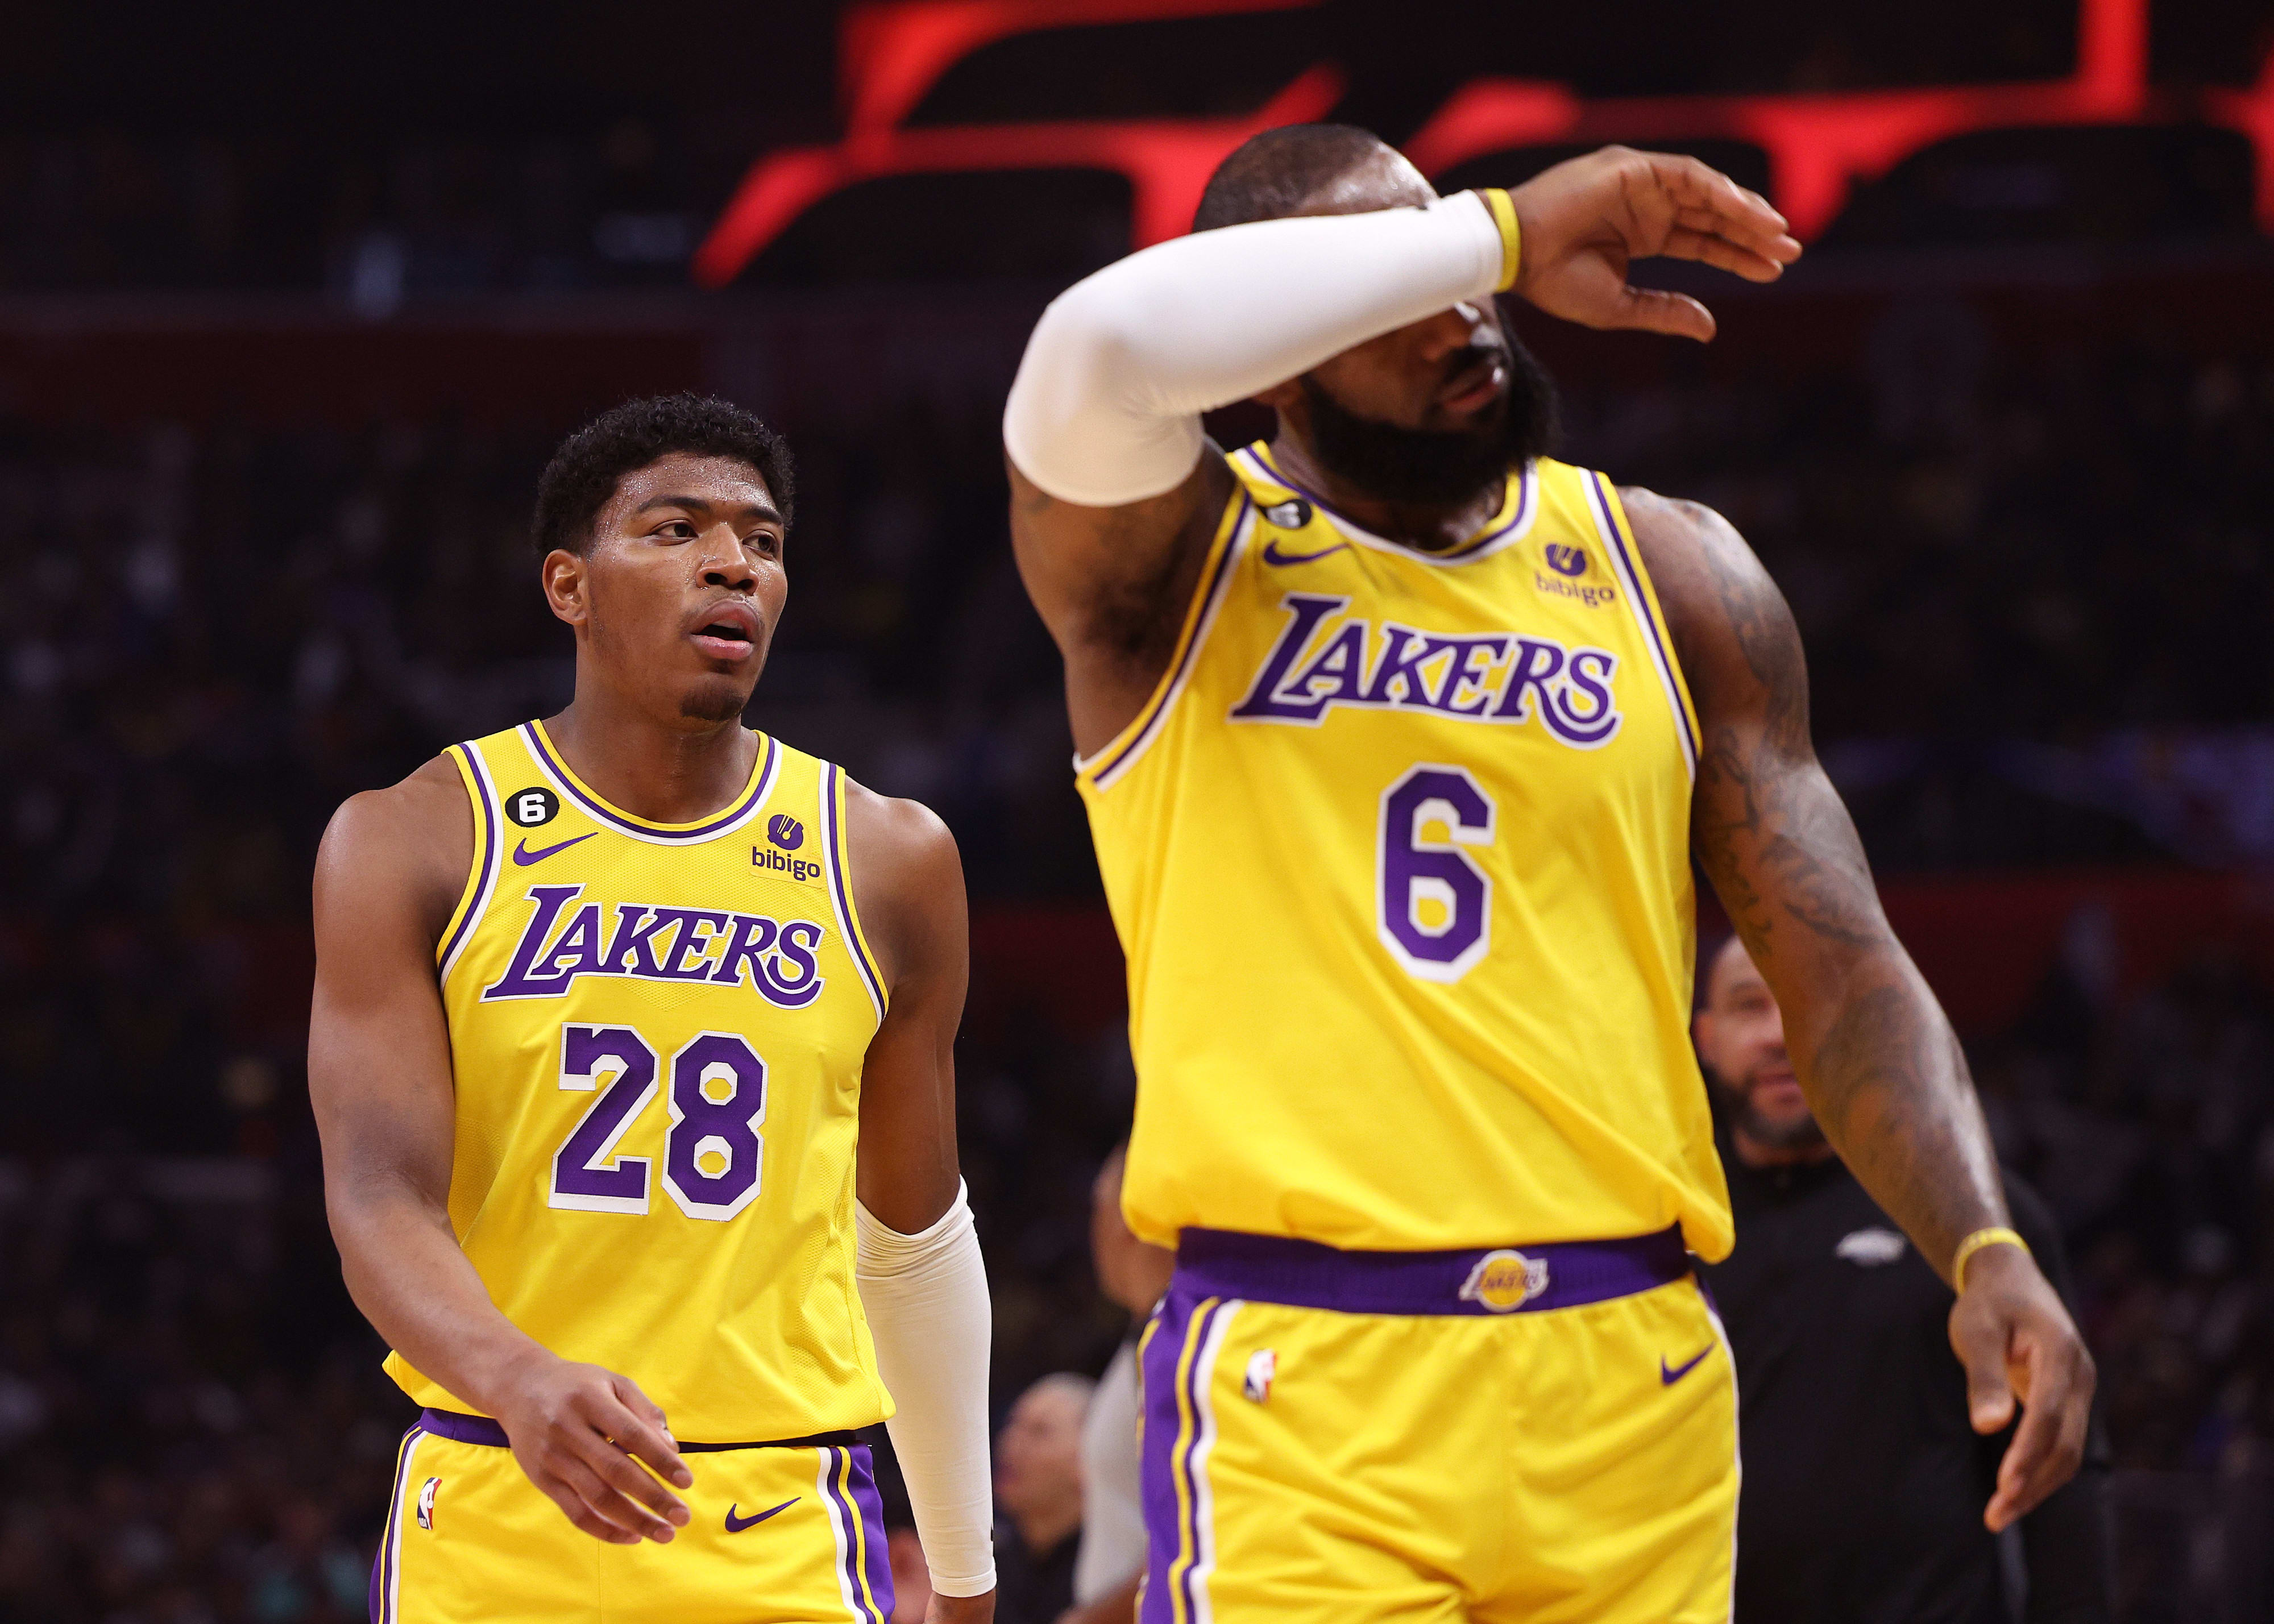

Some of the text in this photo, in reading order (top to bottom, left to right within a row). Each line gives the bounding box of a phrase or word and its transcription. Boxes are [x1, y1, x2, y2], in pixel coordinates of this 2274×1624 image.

[1535, 570, 1616, 608] bibigo
[1226, 591, 1623, 750] LAKERS
[518, 793, 546, 823] 6
[752, 846, 820, 881] bibigo
[1375, 761, 1496, 985] 6
[479, 883, 825, 1009] LAKERS
[547, 1021, 768, 1222] 28
